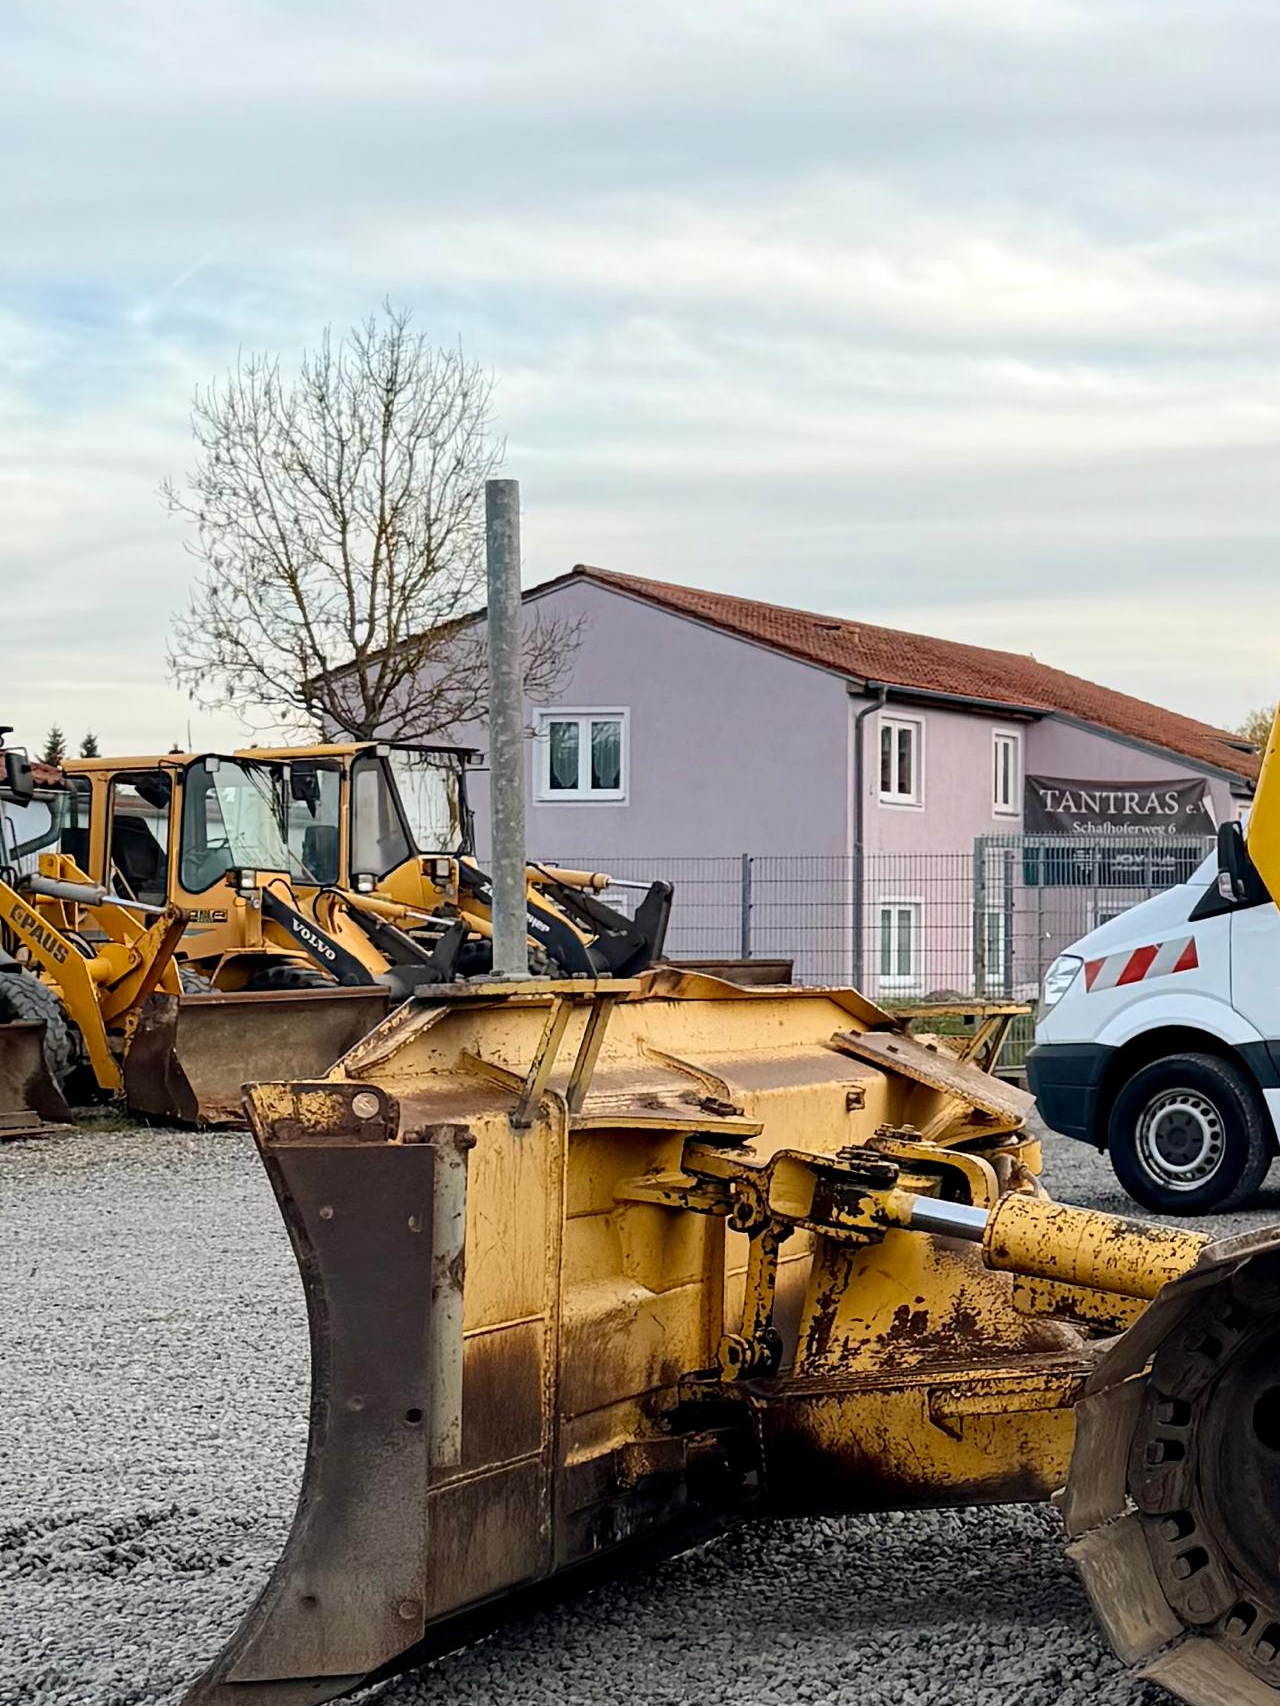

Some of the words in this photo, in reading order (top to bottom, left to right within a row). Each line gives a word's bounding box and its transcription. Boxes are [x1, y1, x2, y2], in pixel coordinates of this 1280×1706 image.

[1040, 789, 1179, 815] TANTRAS
[1073, 821, 1166, 836] Schafhoferweg
[1168, 823, 1177, 835] 6
[20, 911, 69, 964] PAUS
[292, 917, 337, 961] VOLVO
